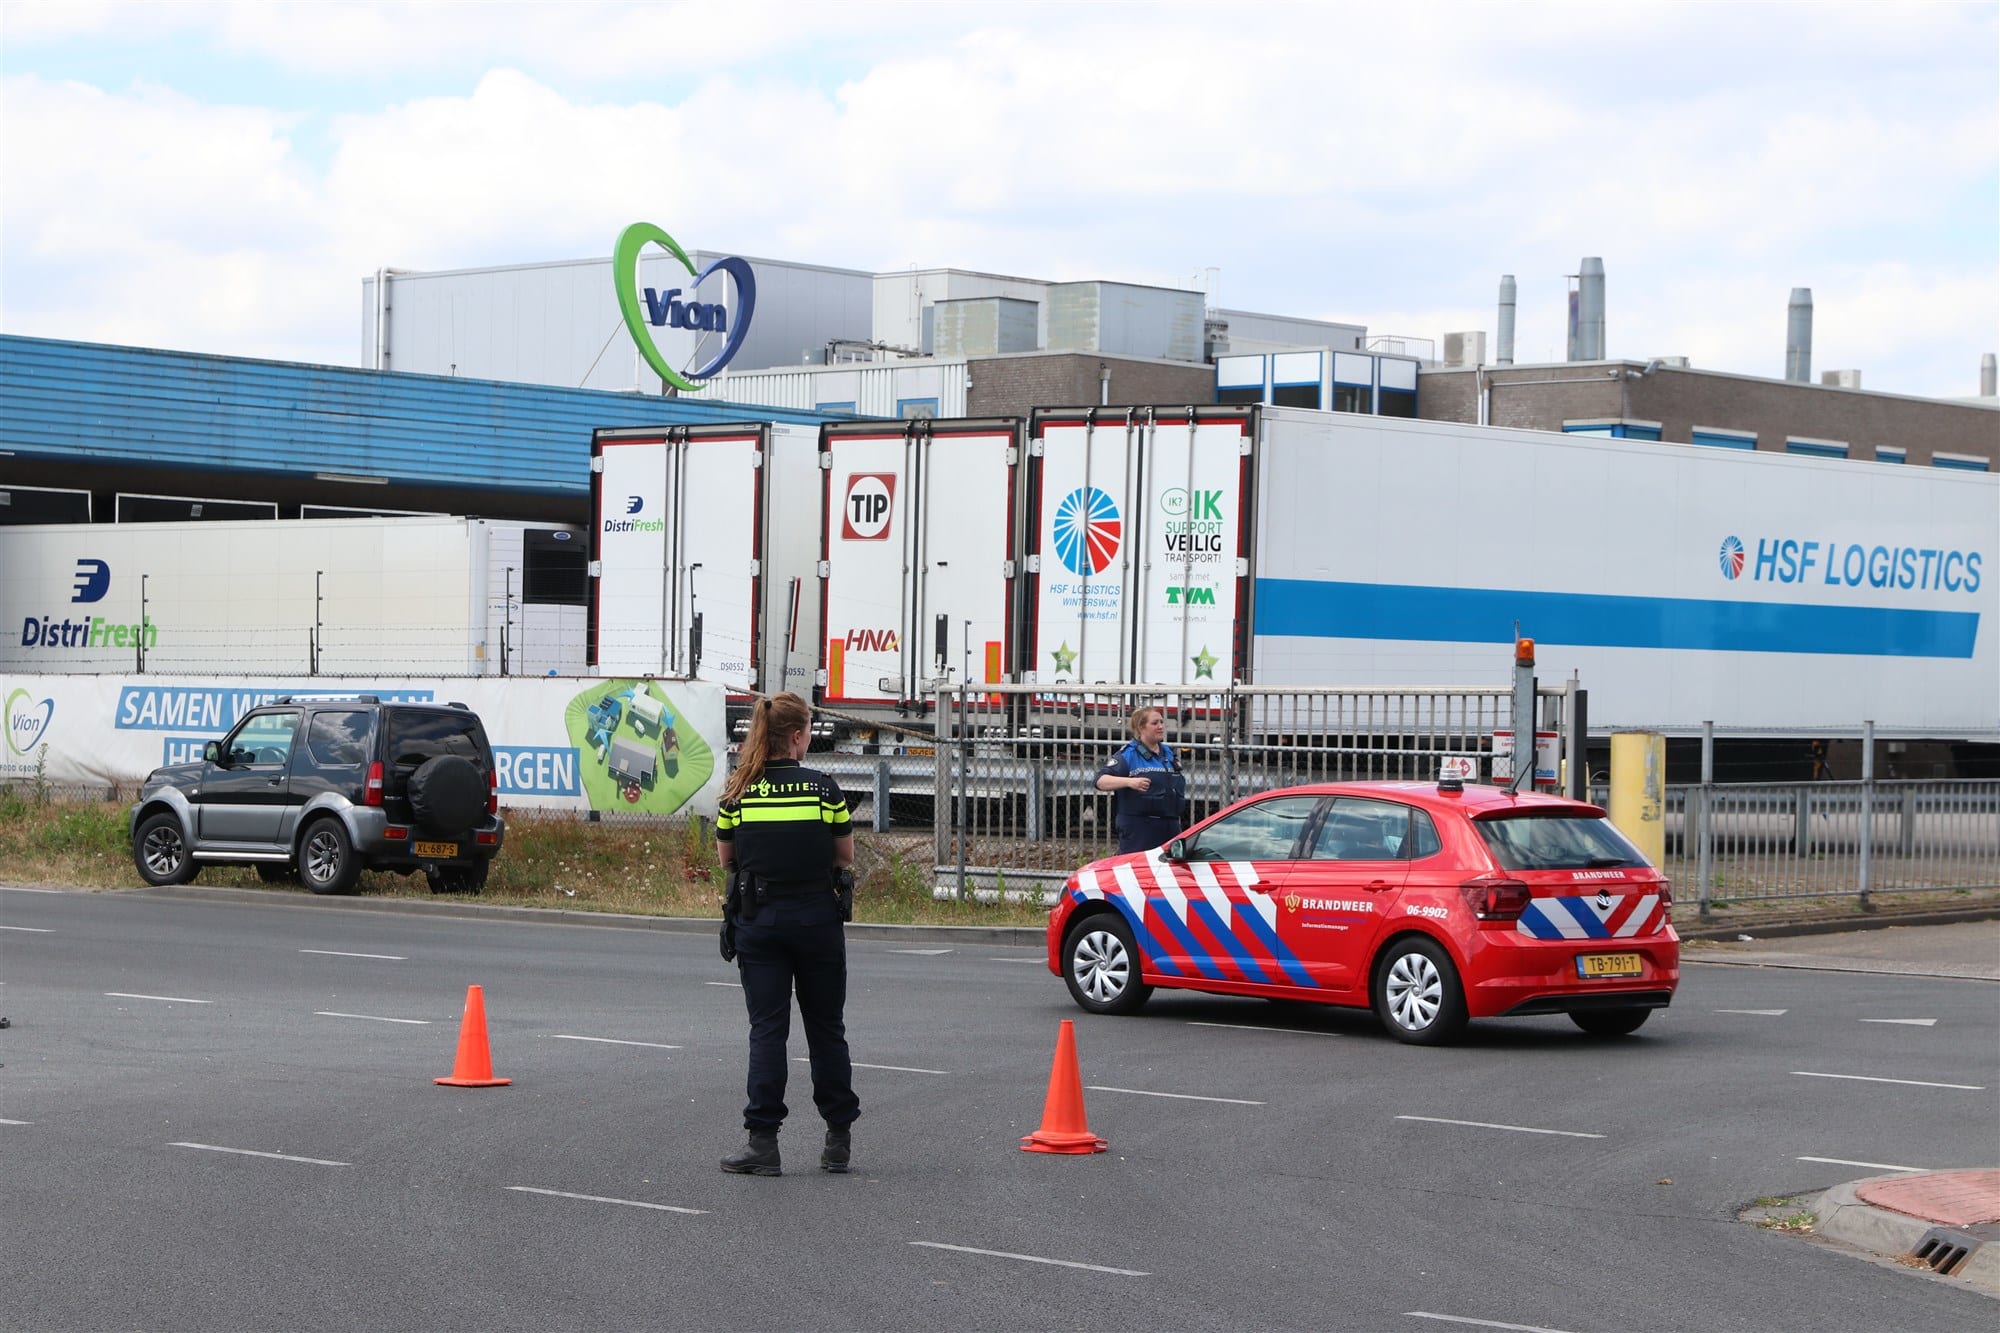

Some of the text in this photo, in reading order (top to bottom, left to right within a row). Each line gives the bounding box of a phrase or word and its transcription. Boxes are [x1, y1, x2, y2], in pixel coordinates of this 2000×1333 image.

[643, 287, 727, 332] Vion
[850, 493, 888, 523] TIP
[1193, 489, 1224, 520] IK
[604, 518, 664, 532] DistriFresh
[1165, 521, 1223, 534] SUPPORT
[1165, 534, 1222, 552] VEILIG
[1754, 538, 1983, 593] HSF LOGISTICS
[1169, 572, 1194, 581] samn
[1050, 584, 1120, 595] HSF LOGISTICS
[1165, 586, 1216, 605] TVM
[21, 615, 158, 648] DistriFresh
[845, 629, 899, 653] HNA
[121, 688, 223, 728] SAMEN
[13, 713, 40, 731] Vion
[750, 781, 810, 797] POLITIE
[416, 843, 455, 855] XL-687-S
[1572, 871, 1626, 880] BRANDWEER
[1302, 898, 1374, 913] BRANDWEER
[1406, 904, 1448, 919] 06-9902
[1588, 956, 1636, 972] TB-791-T
